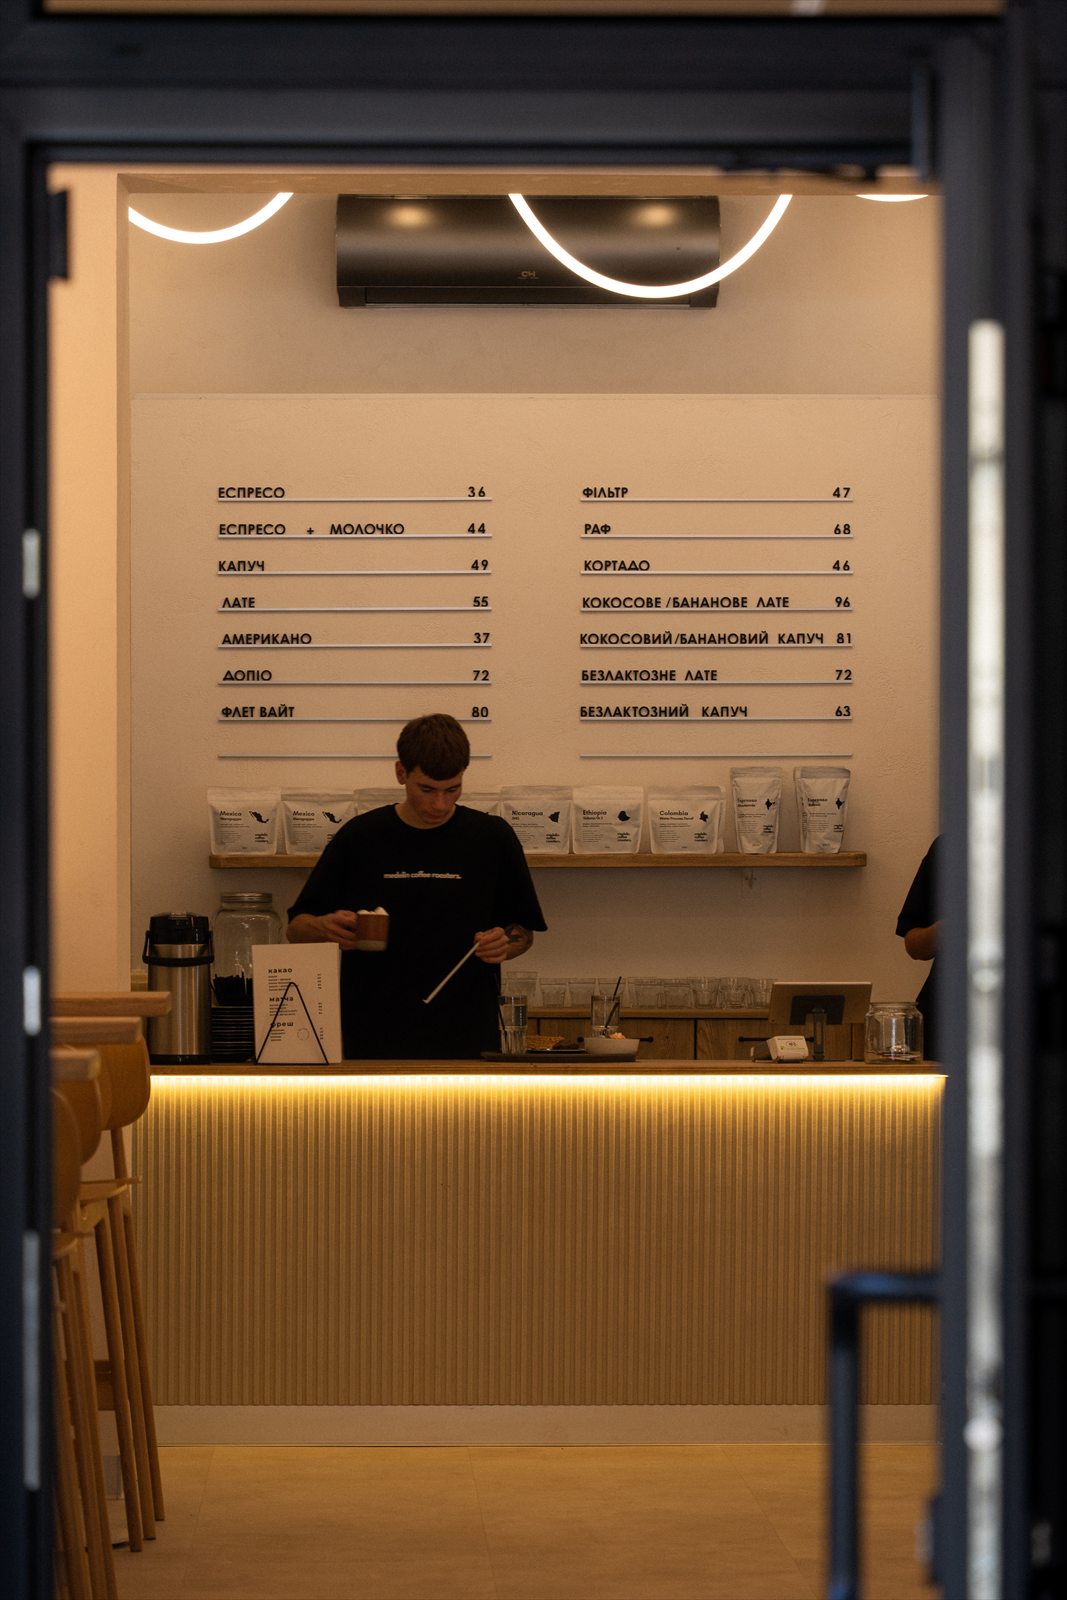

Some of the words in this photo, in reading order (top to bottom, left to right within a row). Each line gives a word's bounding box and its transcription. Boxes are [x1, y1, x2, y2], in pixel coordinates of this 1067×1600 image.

[219, 487, 285, 498] ЕСПРЕСО
[468, 487, 485, 497] 36
[583, 487, 628, 498] ФІЛЬТР
[833, 487, 850, 498] 47
[220, 524, 285, 535] ЕСПРЕСО
[330, 524, 404, 534] МОЛОЧКО
[468, 523, 485, 534] 44
[585, 524, 611, 534] РАФ
[834, 524, 850, 534] 68
[219, 561, 264, 571] КАПУЧ
[471, 560, 488, 570] 49
[585, 560, 650, 571] КОРТАДО
[833, 560, 850, 571] 46
[222, 597, 255, 608] ЛАТЕ
[473, 596, 488, 607] 55
[583, 597, 661, 608] КОКОСОВЕ
[757, 597, 789, 607] ЛАТЕ
[835, 597, 850, 607] 96
[222, 633, 311, 644] АМЕРИКАНО
[474, 633, 490, 643] 37
[778, 633, 823, 644] КАПУЧ
[837, 633, 851, 643] 81
[223, 670, 272, 681] ДОПІО
[473, 670, 489, 681] 72
[582, 670, 675, 681] БЕЗЛАКТОЗНЕ
[685, 670, 717, 680] ЛАТЕ
[836, 669, 851, 680] 72
[222, 707, 255, 717] ФЛЕТ
[260, 704, 294, 717] ВАЙТ
[472, 707, 488, 717] 80
[580, 704, 688, 717] БЕЗЛАКТОЗНИЙ
[702, 707, 747, 717] КАПУЧ
[835, 706, 850, 716] 63
